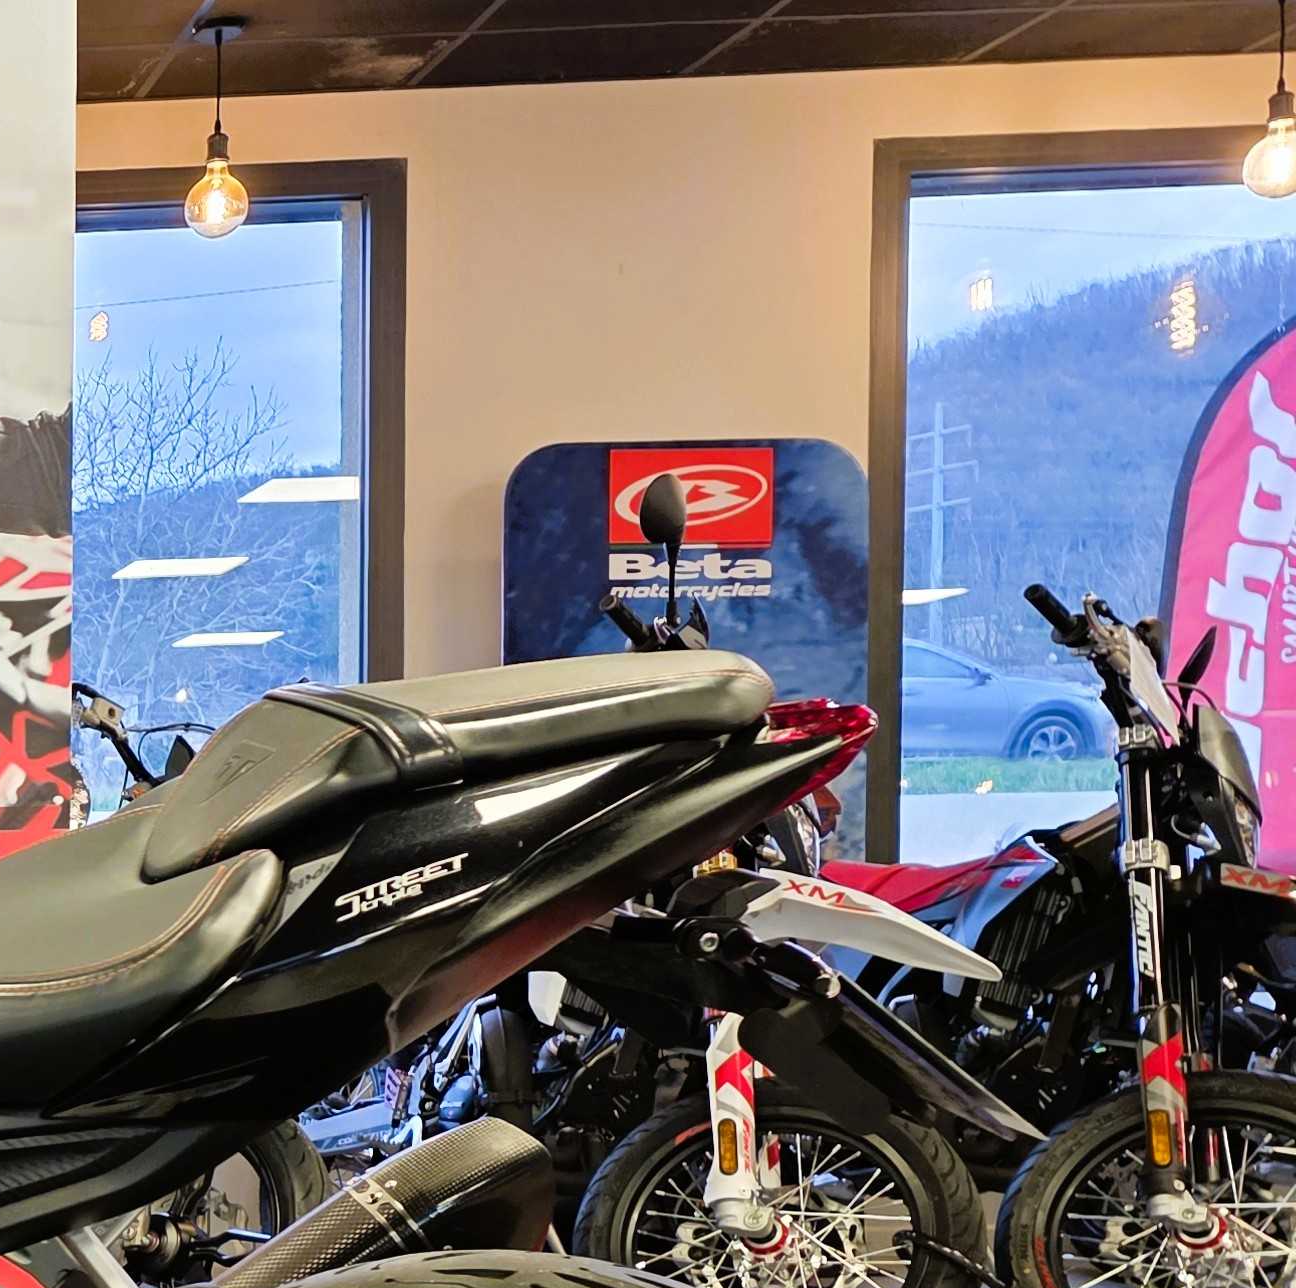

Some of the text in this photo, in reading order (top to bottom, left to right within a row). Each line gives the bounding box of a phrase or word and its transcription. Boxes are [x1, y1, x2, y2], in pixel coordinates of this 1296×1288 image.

[608, 552, 773, 580] Beta
[335, 853, 469, 922] STREET
[782, 878, 846, 904] XM
[1222, 867, 1292, 895] XM
